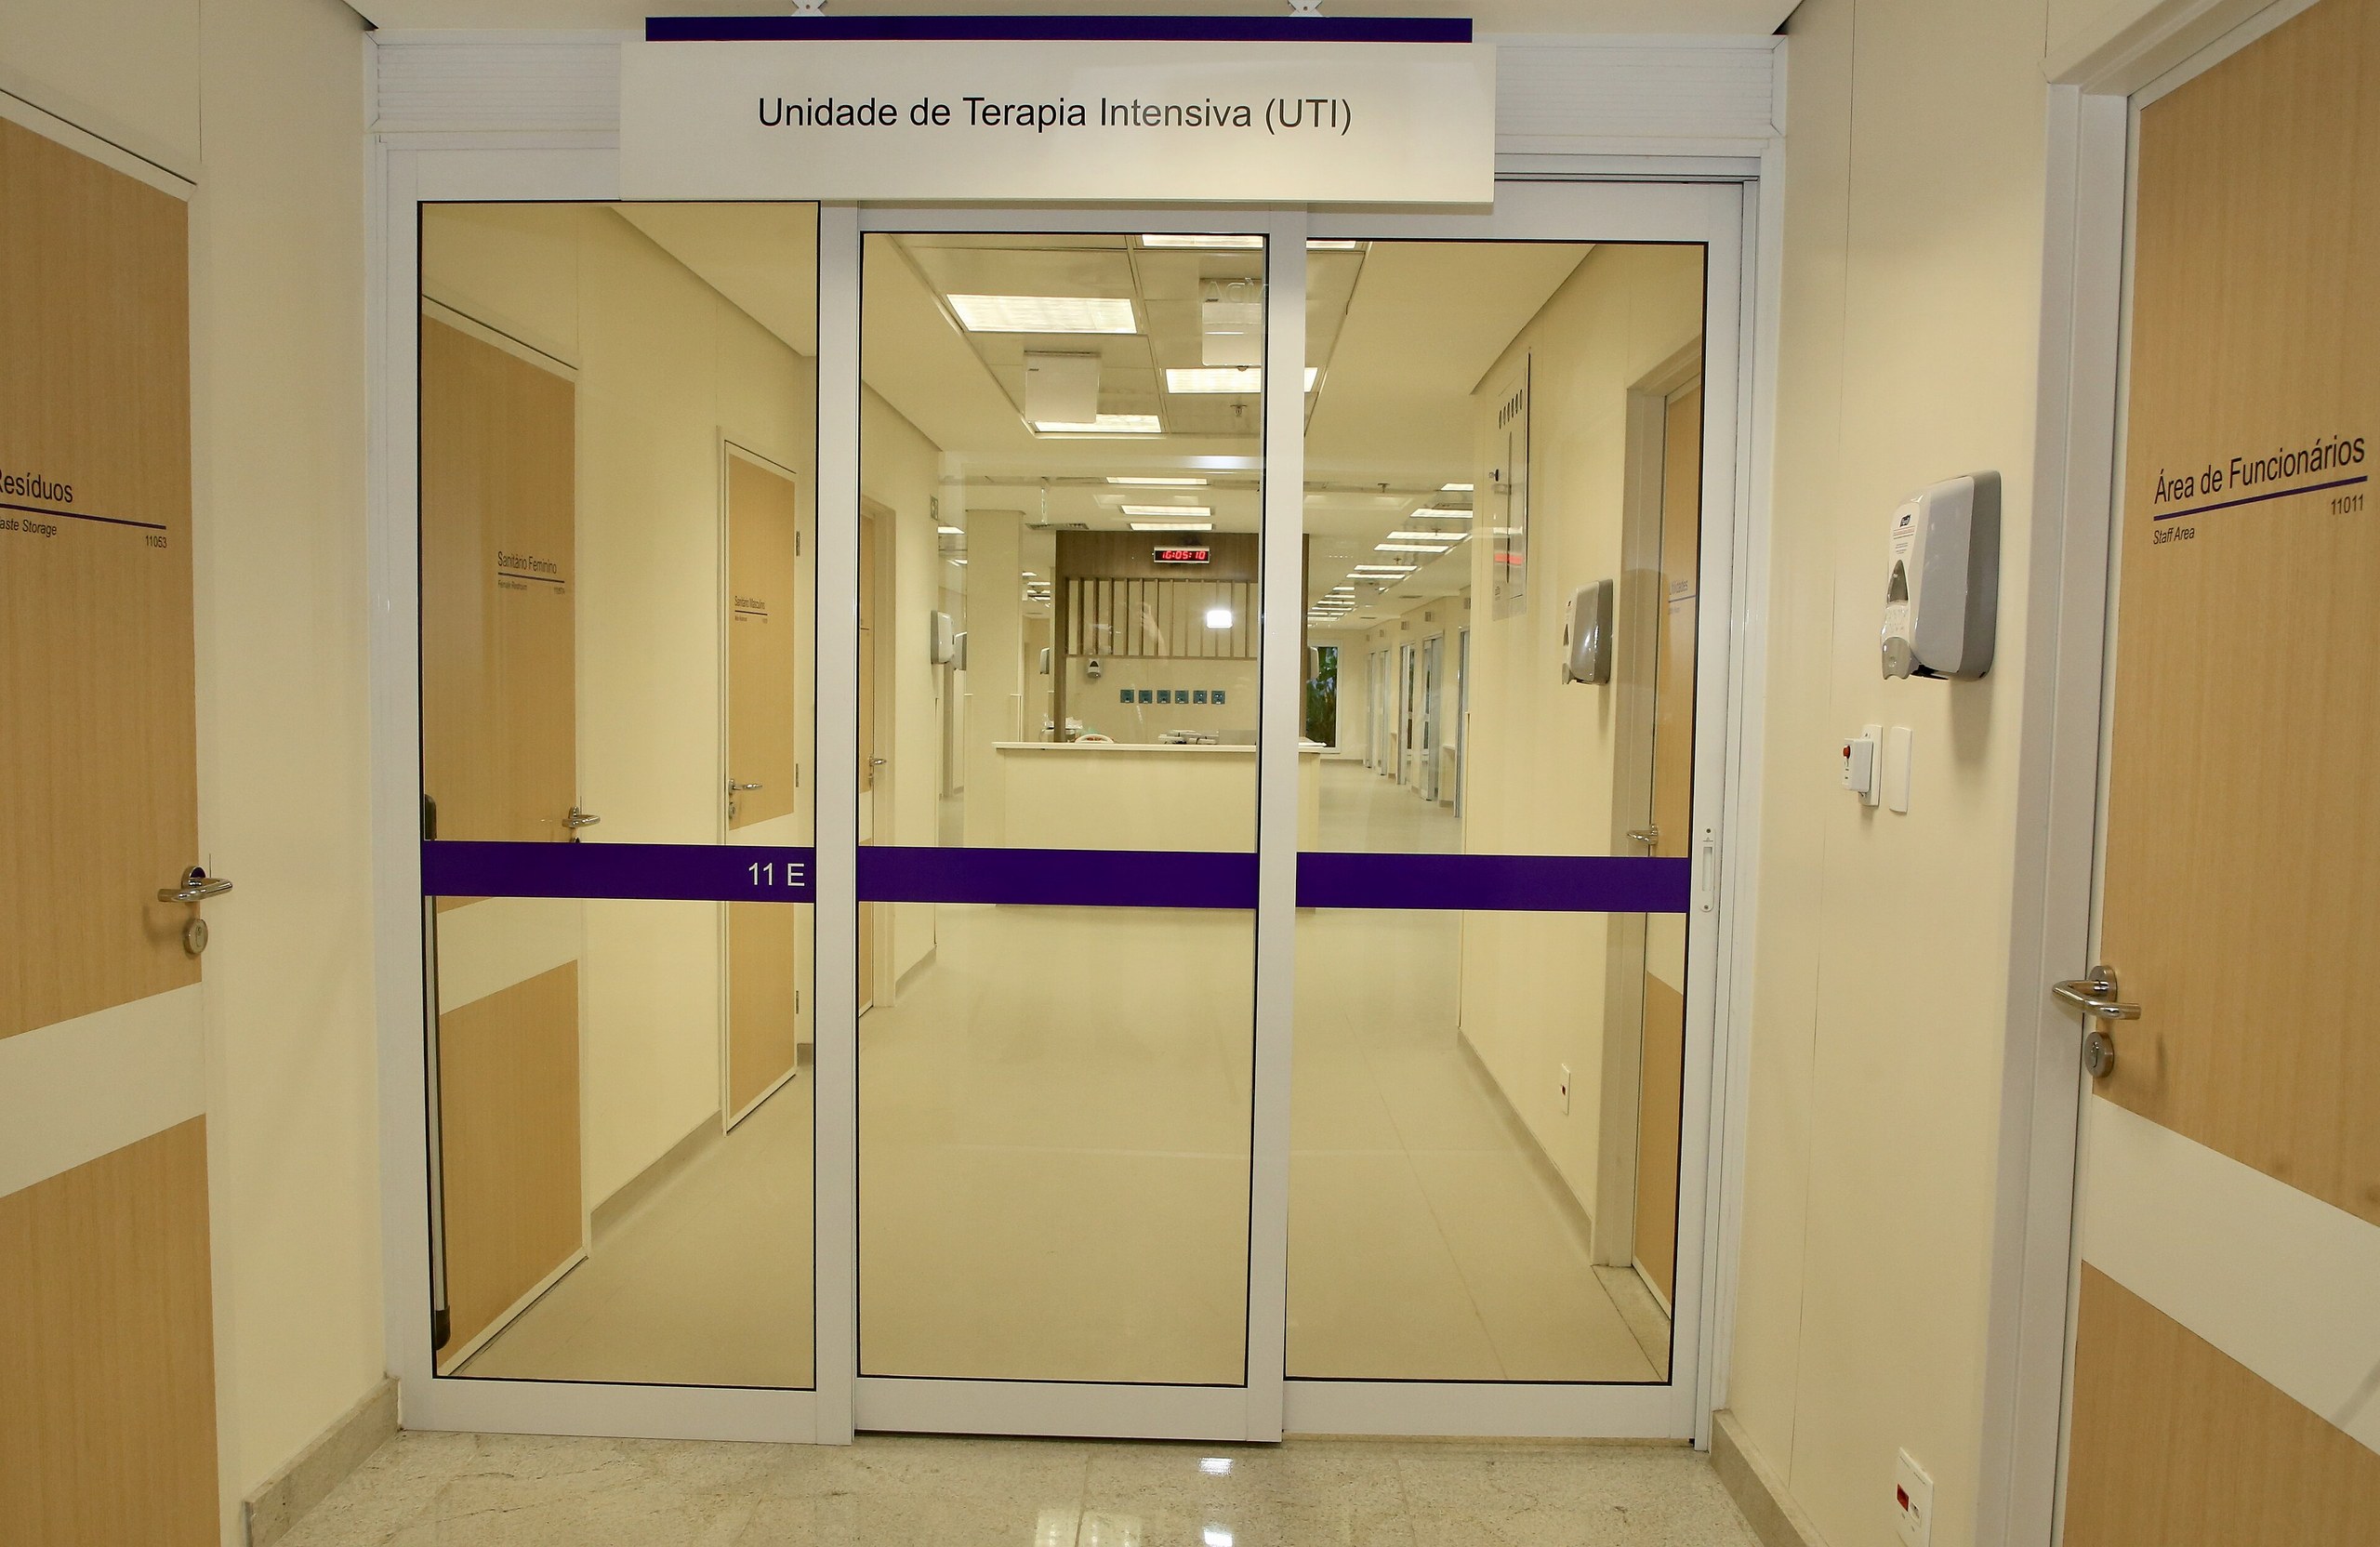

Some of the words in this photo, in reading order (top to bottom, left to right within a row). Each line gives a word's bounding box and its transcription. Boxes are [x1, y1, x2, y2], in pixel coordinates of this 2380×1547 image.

[758, 98, 898, 127] Unidade
[909, 98, 951, 127] de
[963, 98, 1086, 135] Terapia
[1101, 98, 1252, 128] Intensiva
[1264, 98, 1353, 136] (UTI)
[2154, 469, 2194, 504] Área
[2201, 465, 2223, 495] de
[2229, 434, 2365, 489] Funcionários
[2331, 494, 2364, 516] 11011
[22, 519, 58, 537] Storage
[2153, 527, 2174, 545] Staff
[2174, 526, 2195, 541] Area
[145, 535, 167, 549] 11053
[748, 862, 773, 886] 11
[787, 863, 805, 887] E
